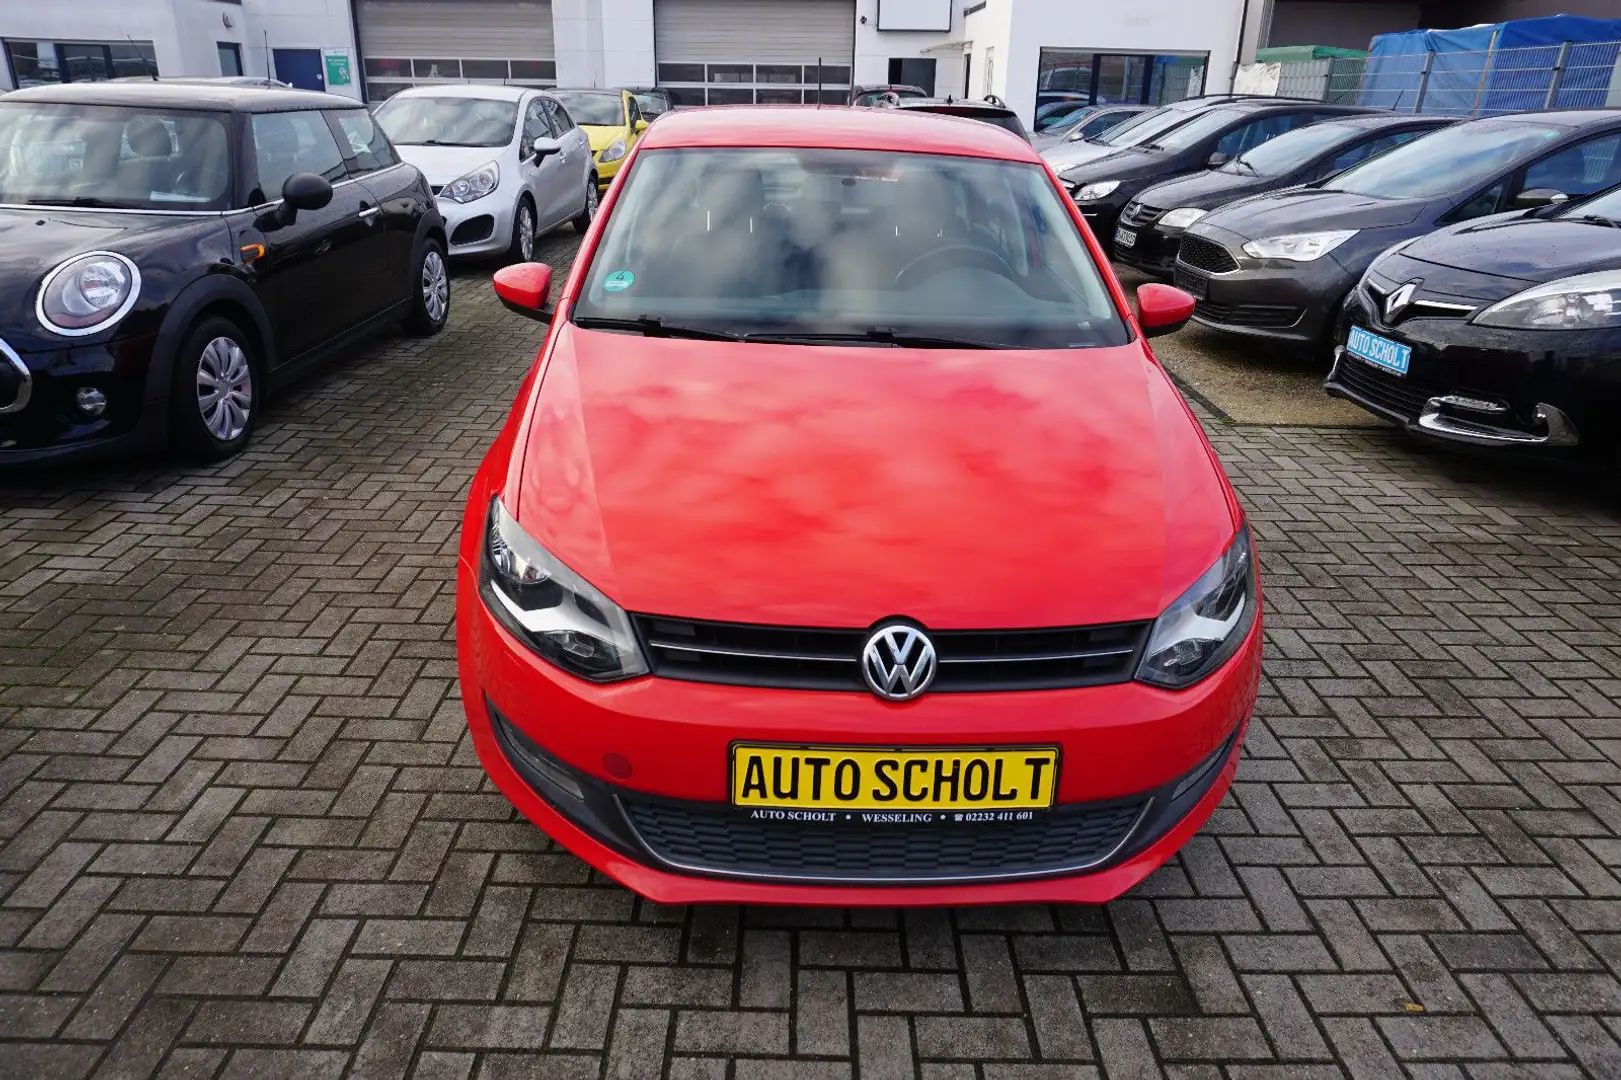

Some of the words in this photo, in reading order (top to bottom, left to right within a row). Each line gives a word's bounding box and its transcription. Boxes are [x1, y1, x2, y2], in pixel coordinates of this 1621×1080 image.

[615, 270, 626, 281] 4
[1347, 330, 1371, 353] AUTO
[1370, 339, 1409, 368] SCHOLT
[741, 755, 861, 801] AUTO
[872, 757, 1050, 802] SCHOLT
[750, 810, 786, 820] AUTO
[787, 811, 836, 822] SCHOLT
[862, 813, 933, 823] WESSELING
[965, 812, 995, 822] 02232
[996, 812, 1014, 821] 411
[1016, 811, 1034, 820] 601
